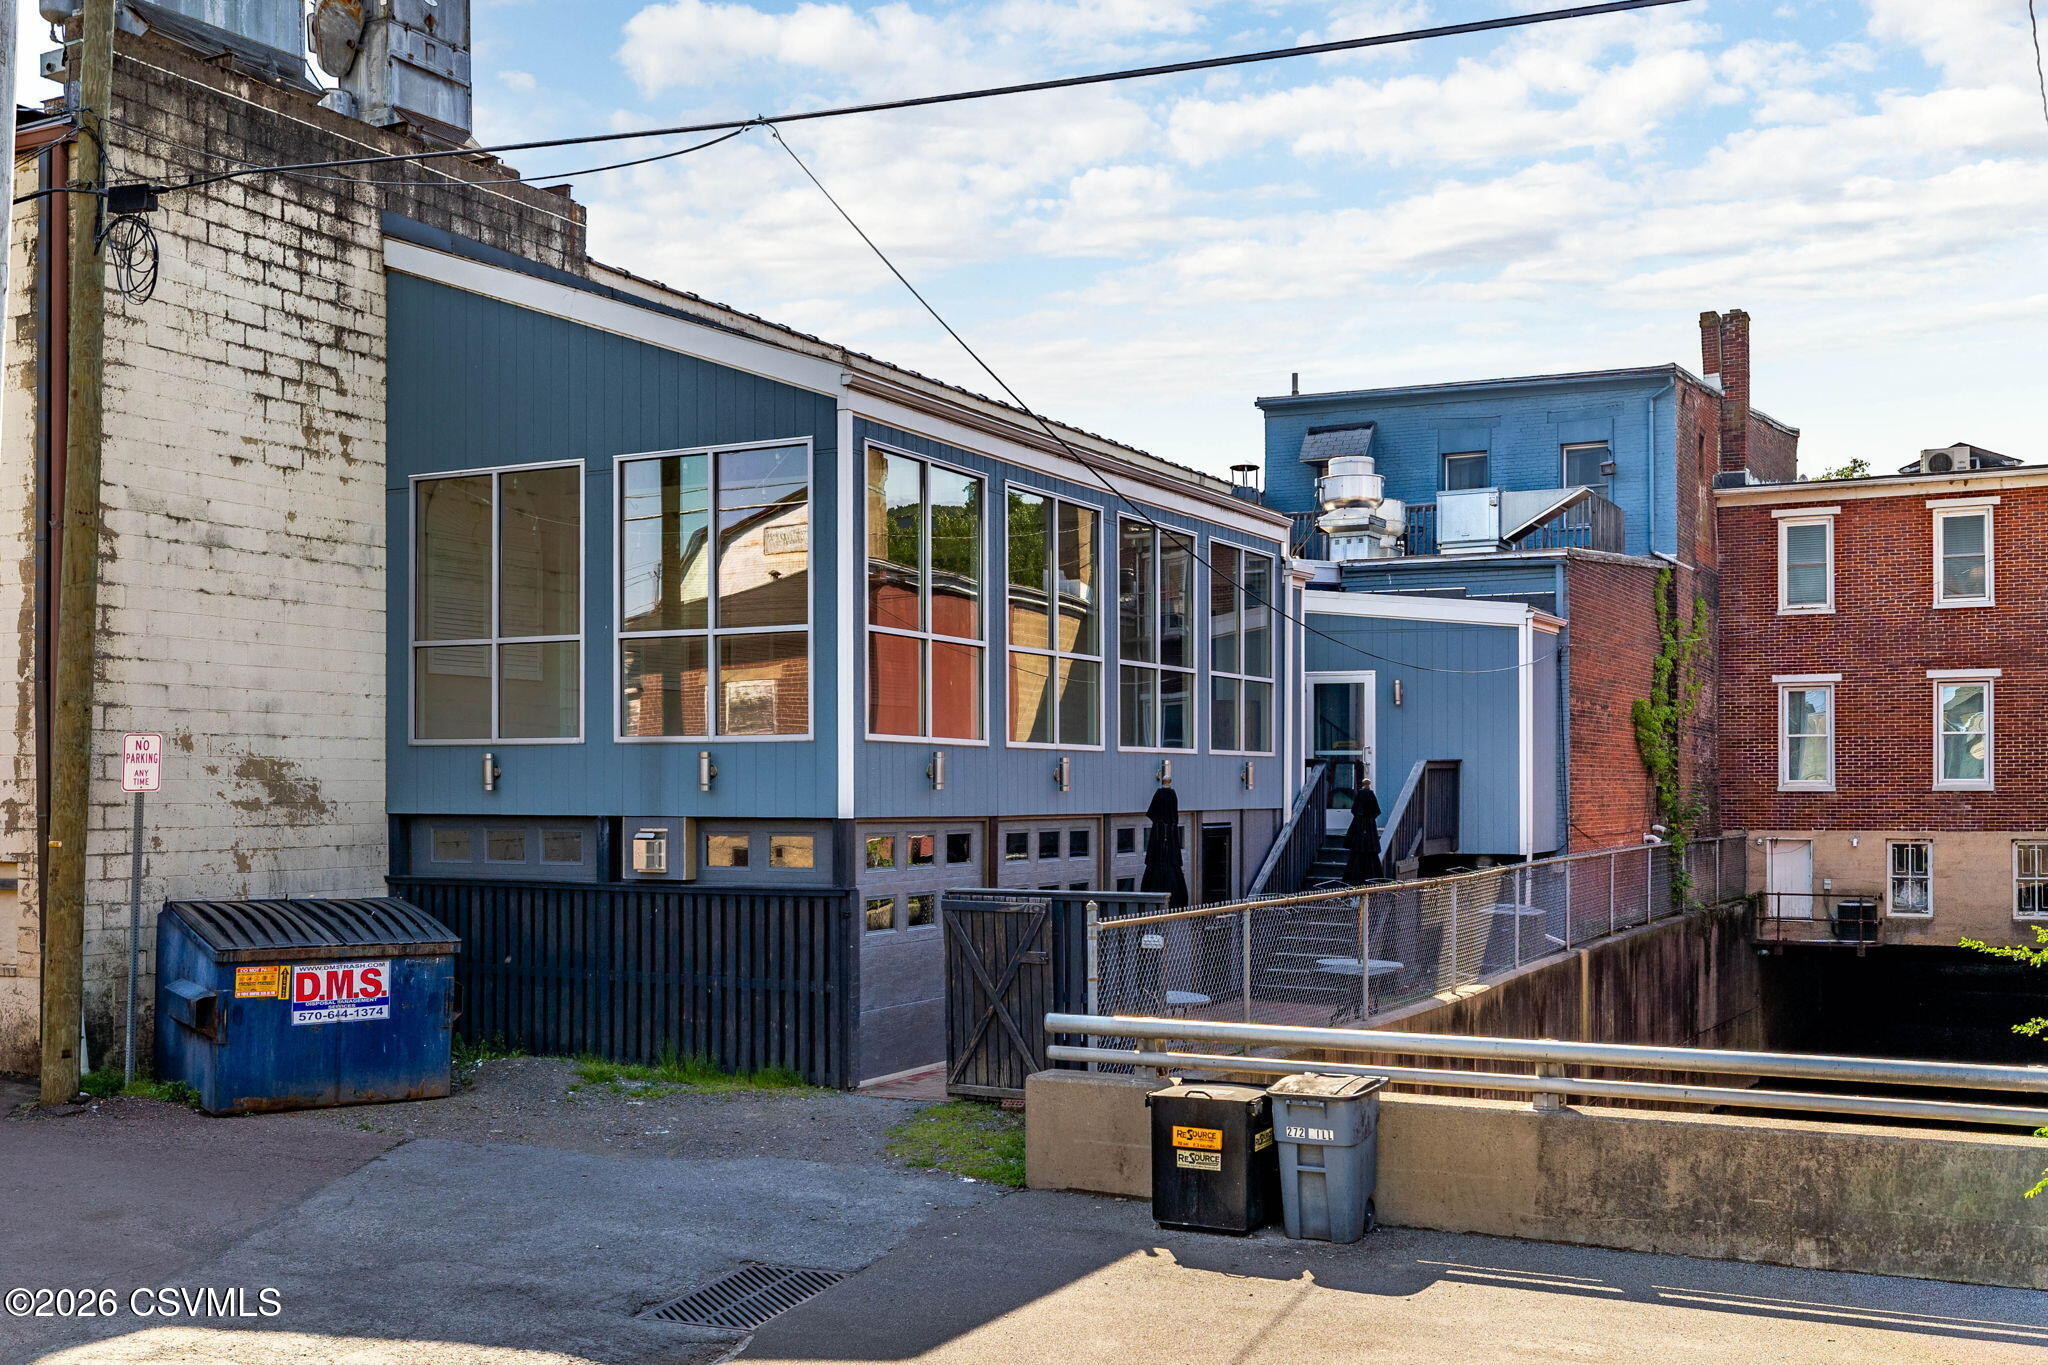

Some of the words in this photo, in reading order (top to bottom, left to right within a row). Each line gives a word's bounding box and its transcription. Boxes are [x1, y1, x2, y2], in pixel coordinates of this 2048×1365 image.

[135, 740, 150, 750] NO
[126, 753, 158, 763] PARKING
[299, 962, 386, 972] WWW.DMSTRASH.COM
[296, 968, 387, 1002] D.M.S.
[299, 1007, 384, 1021] 570-644-1374
[1287, 1127, 1304, 1137] 272
